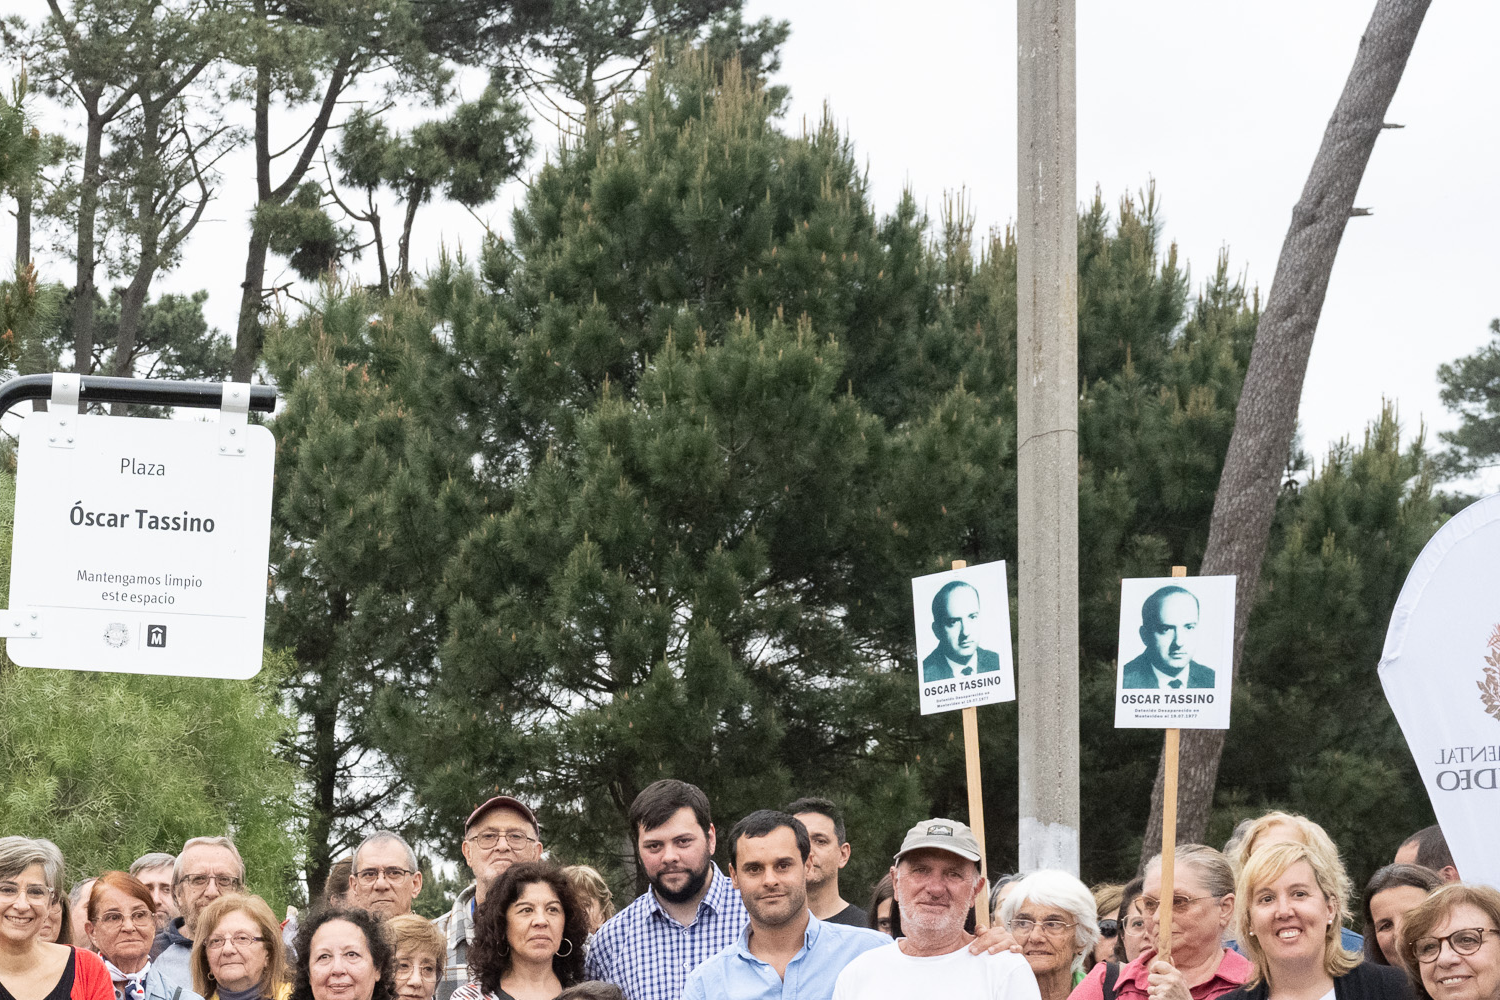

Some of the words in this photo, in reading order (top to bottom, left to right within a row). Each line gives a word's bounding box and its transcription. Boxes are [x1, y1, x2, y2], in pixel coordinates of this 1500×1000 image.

[120, 458, 166, 477] Plaza
[70, 500, 129, 528] Óscar
[135, 508, 215, 533] Tassino
[77, 569, 161, 588] Mantengamos
[164, 574, 203, 589] limpio
[101, 590, 129, 603] este
[130, 592, 175, 606] espacio
[924, 683, 957, 697] OSCAR
[959, 676, 1001, 691] TASSINO
[1121, 694, 1160, 704] OSCAR
[1164, 694, 1214, 704] TASSINO
